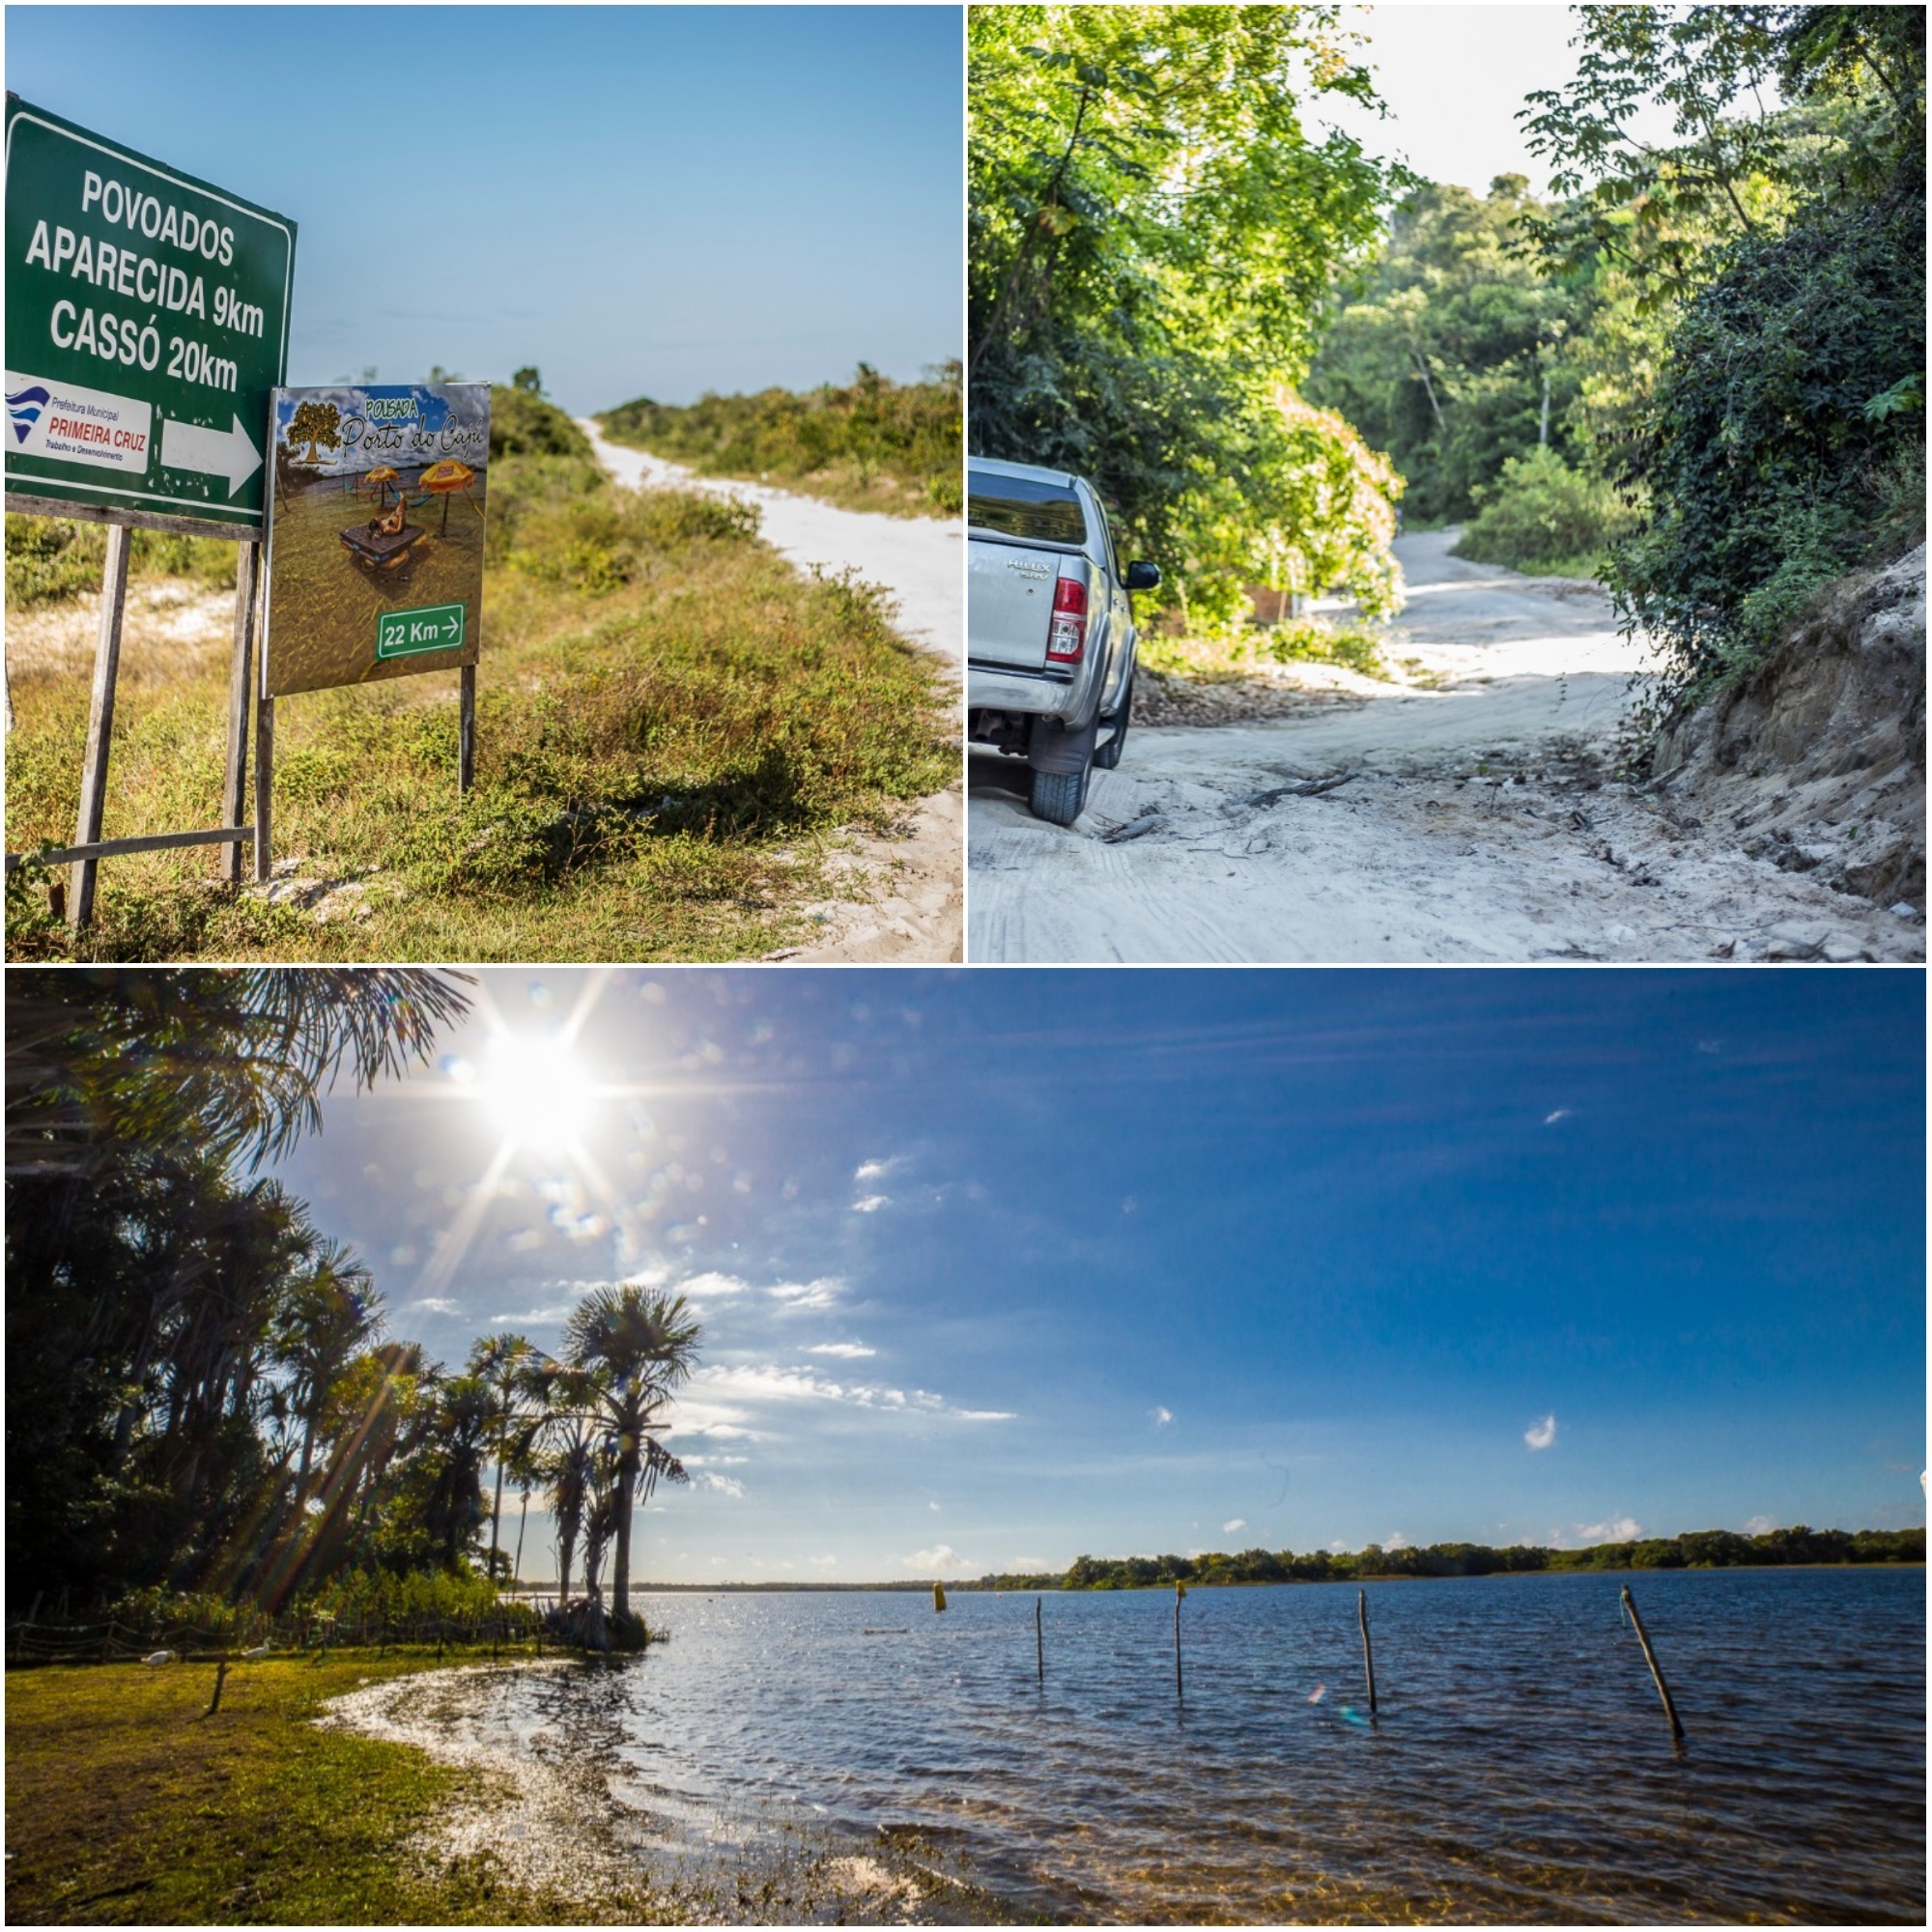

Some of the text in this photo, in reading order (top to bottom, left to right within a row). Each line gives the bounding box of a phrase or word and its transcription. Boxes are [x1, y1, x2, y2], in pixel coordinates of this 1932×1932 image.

[82, 170, 234, 267] POVOADOS
[25, 219, 264, 338] APARECIDA 9km
[51, 299, 238, 392] CASSÓ 20km
[52, 397, 119, 422] Prefeitura Municipal
[365, 398, 418, 419] POUSADA
[49, 417, 147, 451] PRIMEIRA CRUZ
[342, 417, 403, 459] Porto
[412, 413, 435, 448] do
[45, 439, 71, 453] Trabalho
[77, 444, 123, 462] Desenvolvimento
[1008, 559, 1051, 573] HILUX
[1020, 572, 1049, 581] SRV
[384, 621, 439, 646] 22 Km
